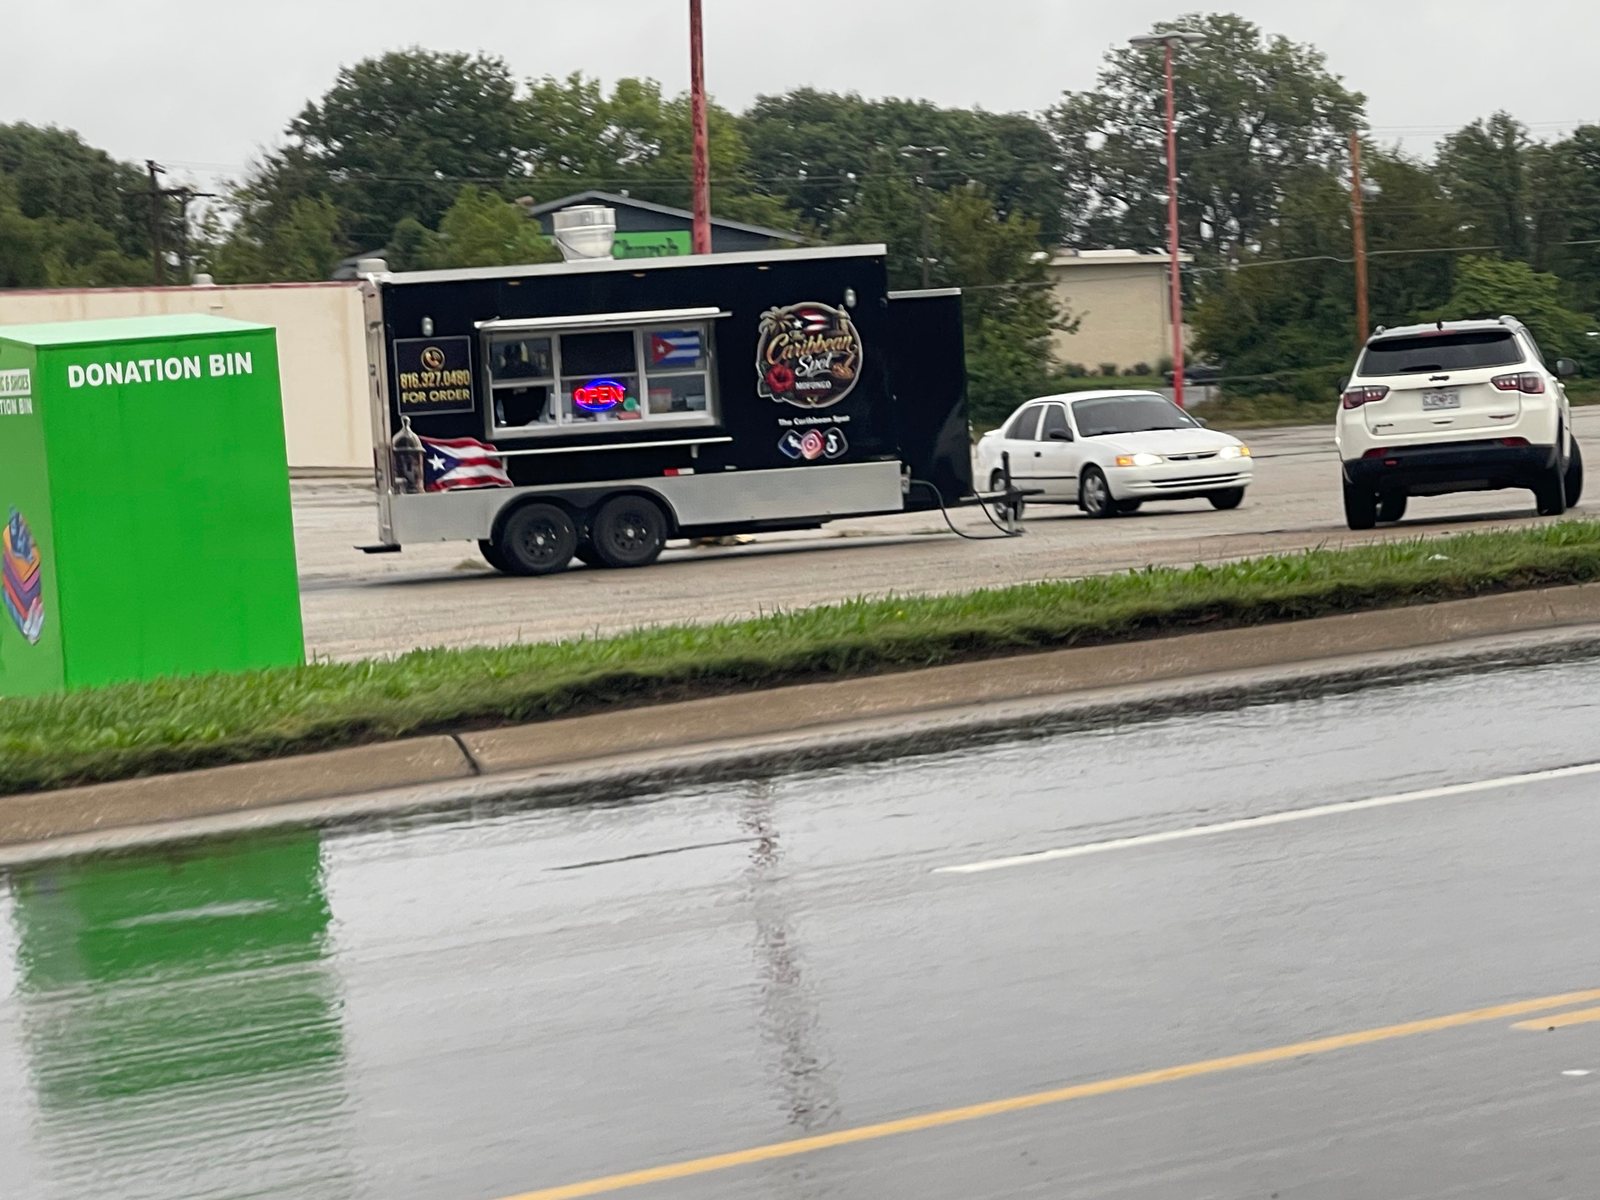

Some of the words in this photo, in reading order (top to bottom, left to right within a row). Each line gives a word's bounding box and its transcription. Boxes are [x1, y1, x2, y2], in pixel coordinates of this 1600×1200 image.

[612, 238, 679, 260] Church
[767, 333, 858, 365] Caribbean
[68, 355, 201, 388] DONATION
[209, 351, 253, 377] BIN
[402, 391, 427, 403] FOR
[429, 388, 470, 402] ORDER
[573, 385, 625, 404] OPEN
